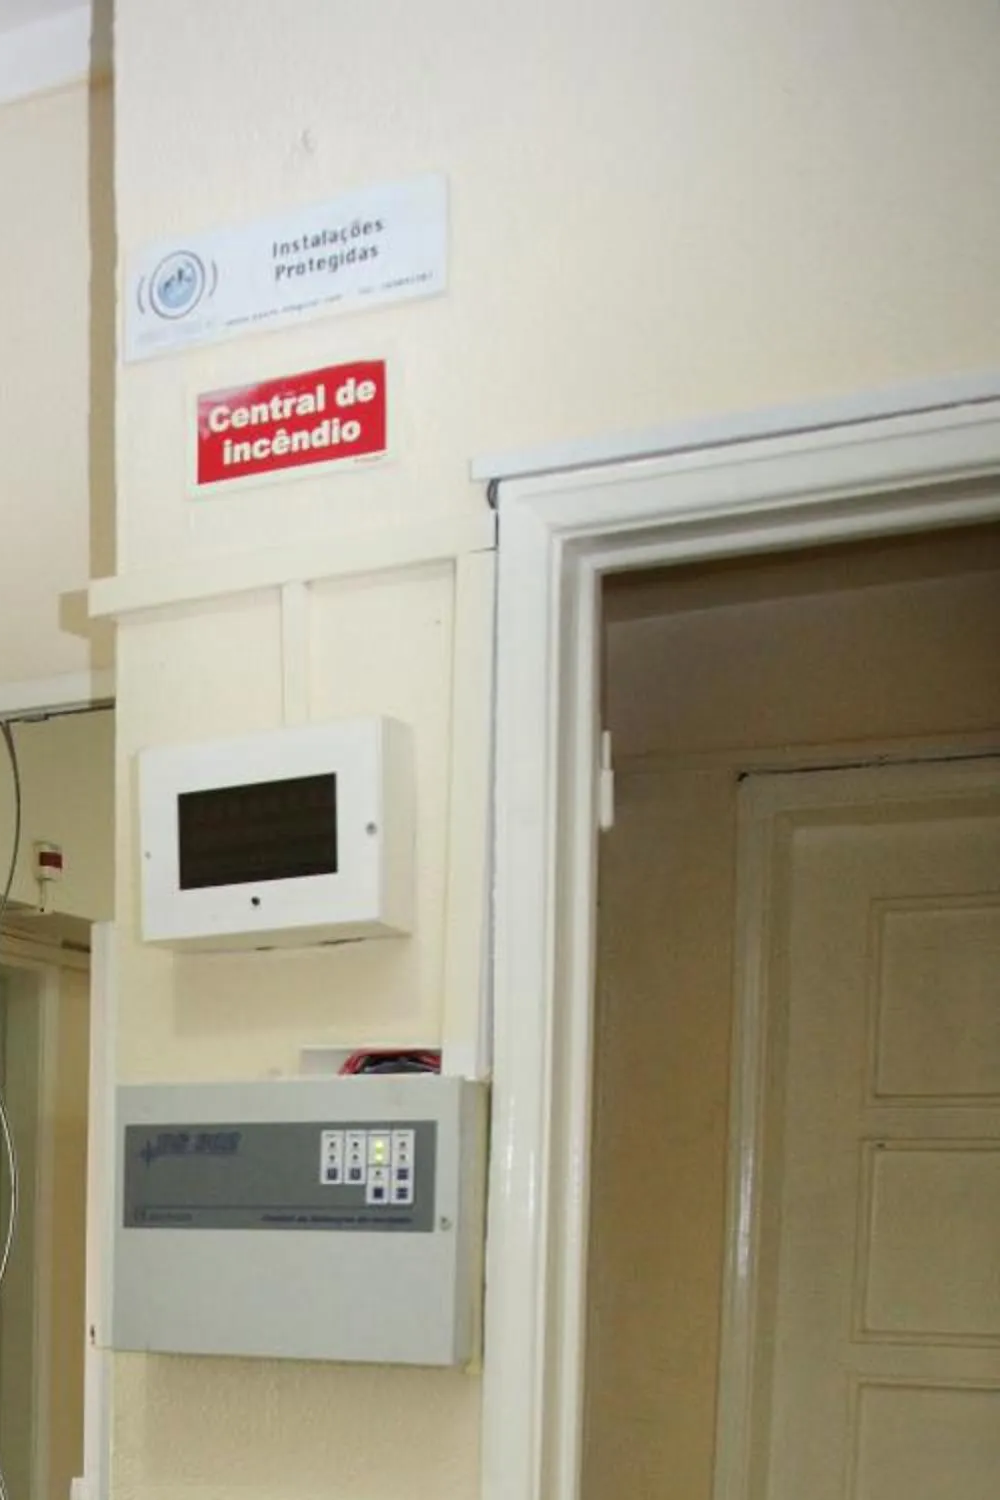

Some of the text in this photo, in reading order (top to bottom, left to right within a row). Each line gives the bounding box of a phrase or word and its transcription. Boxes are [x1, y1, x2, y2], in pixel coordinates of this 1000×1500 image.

[272, 217, 386, 258] Instalações
[274, 244, 380, 281] Protegidas
[207, 377, 377, 433] Central de
[222, 417, 362, 466] incêndio
